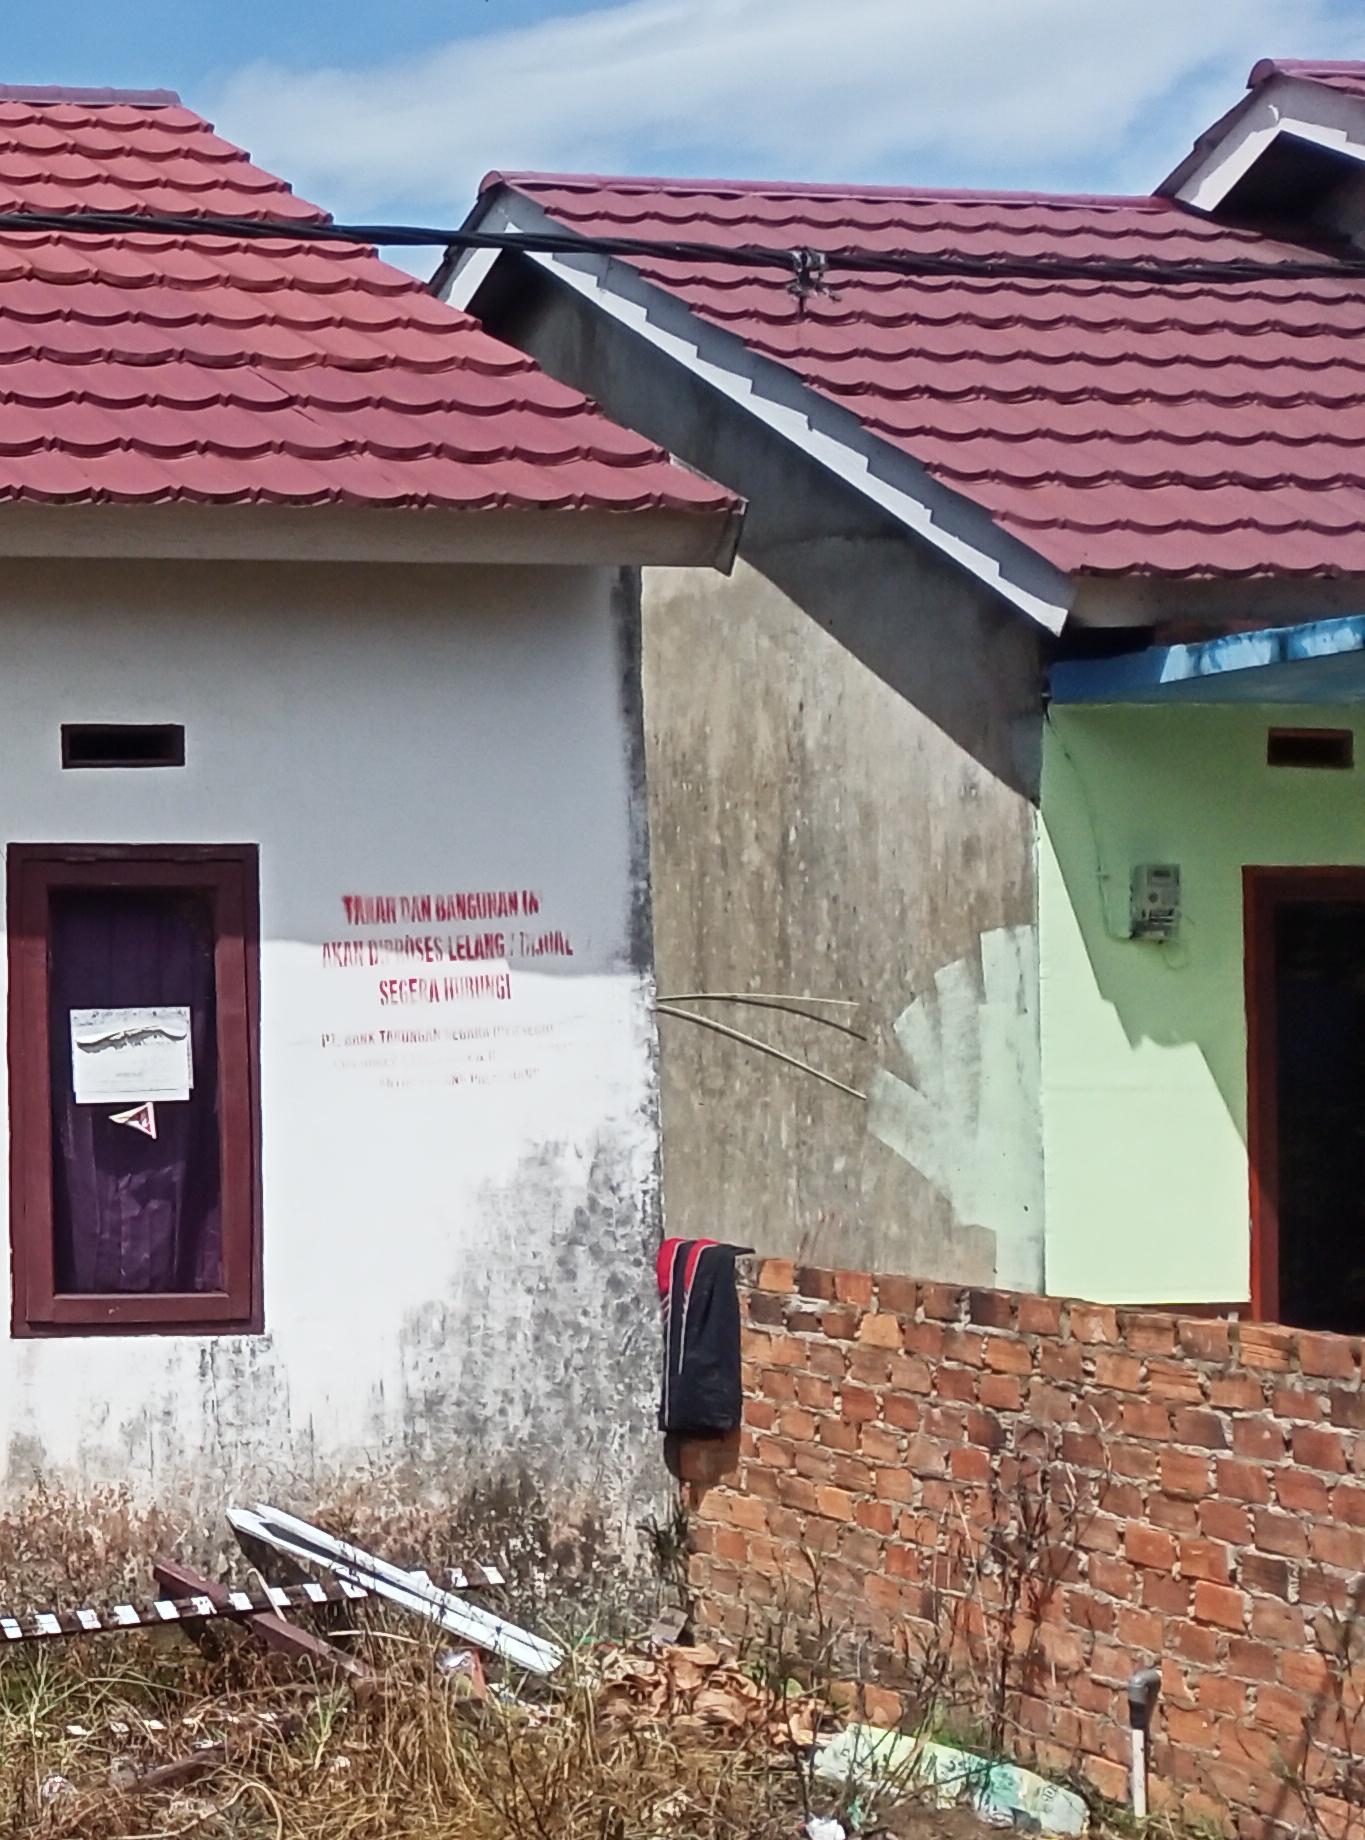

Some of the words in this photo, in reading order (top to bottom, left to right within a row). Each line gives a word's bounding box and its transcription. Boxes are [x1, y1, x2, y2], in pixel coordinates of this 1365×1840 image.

[342, 893, 397, 925] TANAH
[400, 894, 432, 922] DAN
[435, 890, 518, 921] BANGUNAN
[521, 888, 541, 917] IN
[322, 940, 364, 968] AKAN
[448, 932, 505, 961] LELANG
[379, 978, 440, 1006] SEGERA
